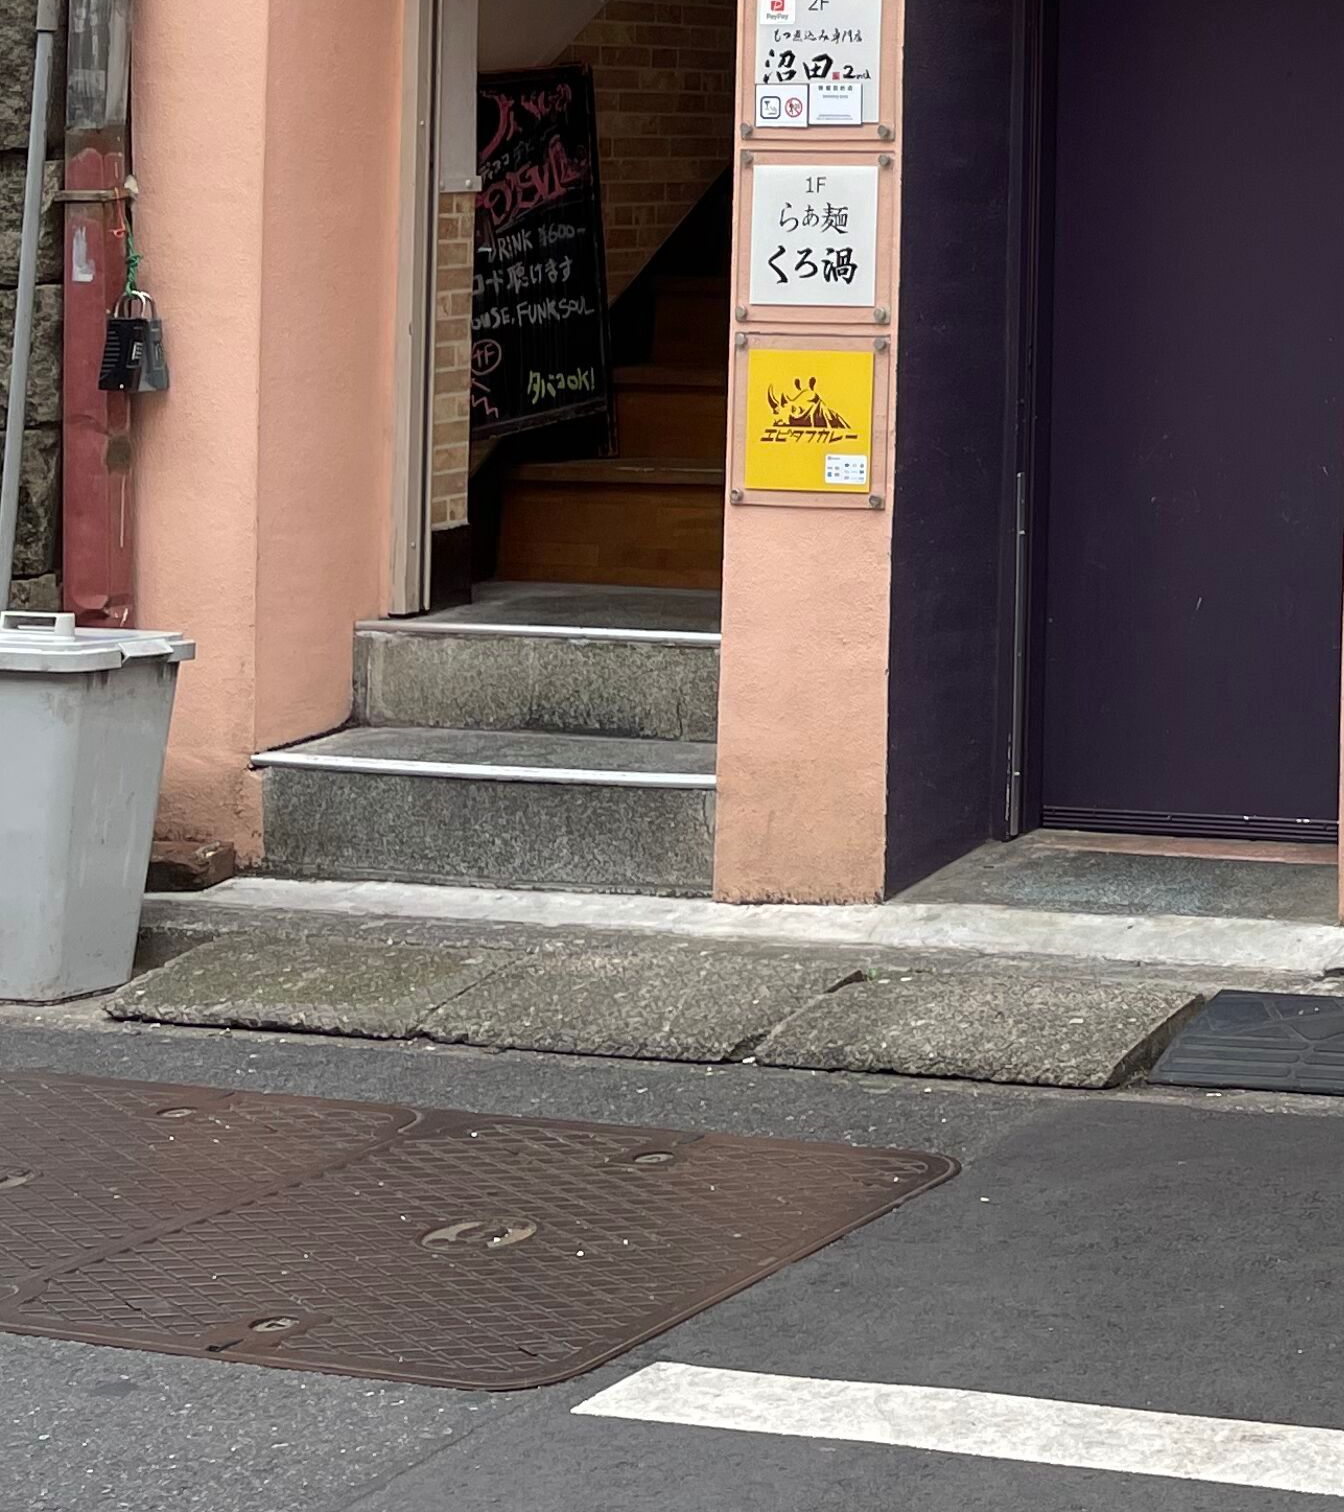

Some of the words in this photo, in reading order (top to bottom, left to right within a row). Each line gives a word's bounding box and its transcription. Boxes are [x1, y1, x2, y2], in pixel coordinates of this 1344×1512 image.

[762, 48, 834, 85] 沼田
[805, 176, 827, 194] 1F
[778, 202, 849, 235] らぁ麺
[767, 244, 858, 285] くろ渦
[759, 428, 859, 444] エピタフカレー
